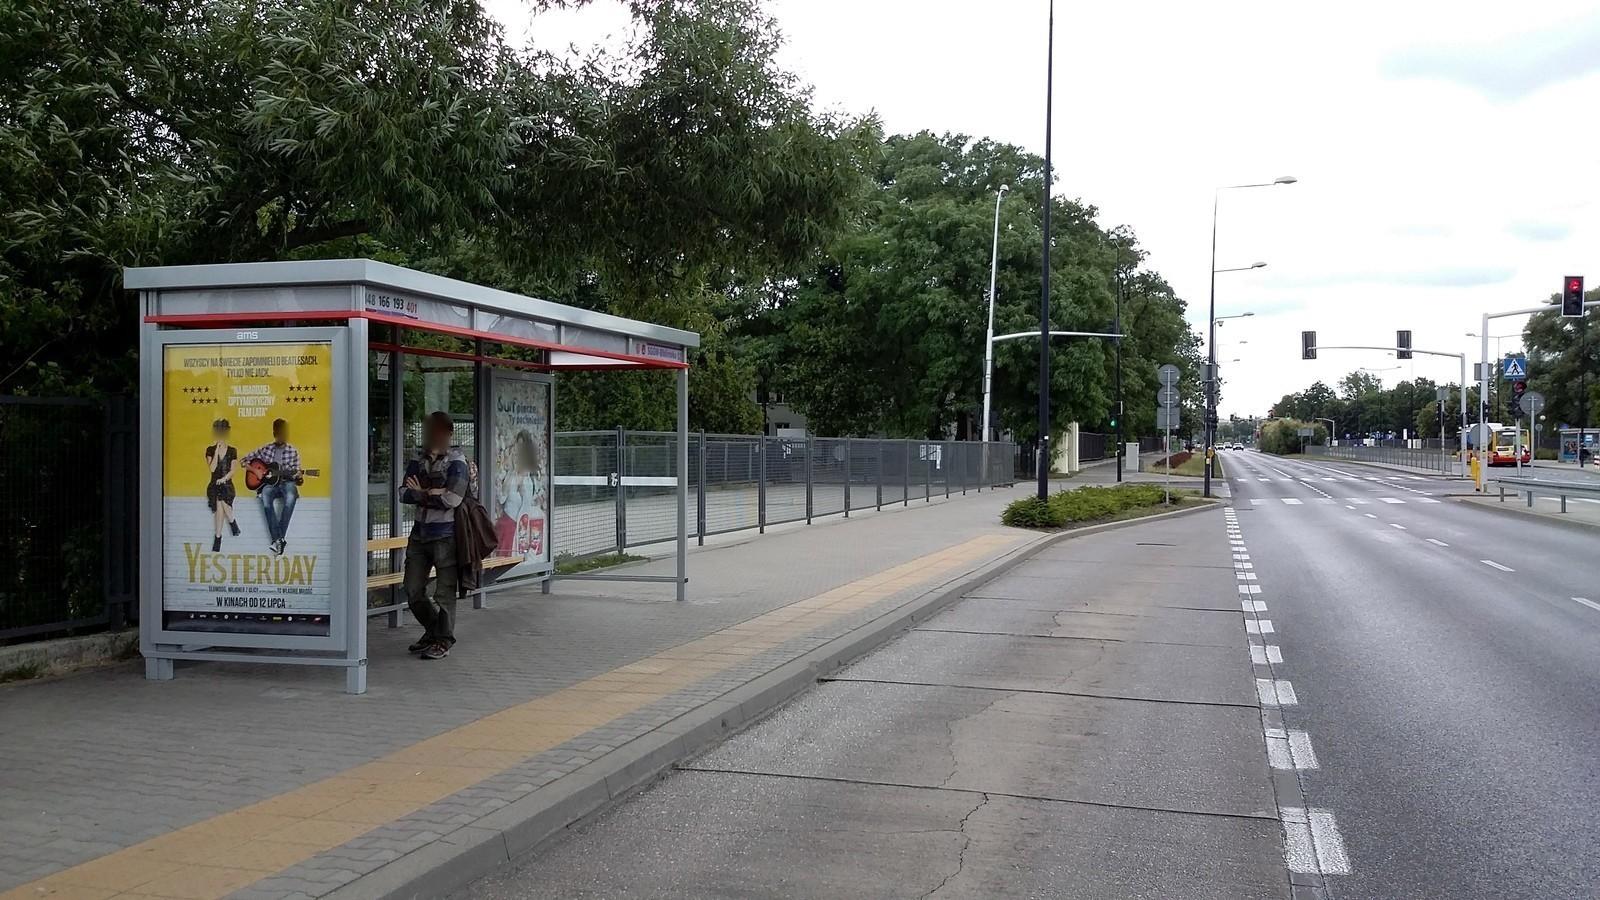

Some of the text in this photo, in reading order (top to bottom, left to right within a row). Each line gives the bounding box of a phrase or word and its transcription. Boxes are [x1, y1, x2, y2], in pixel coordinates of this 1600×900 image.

[379, 295, 390, 308] 166
[393, 297, 404, 310] 193
[406, 301, 418, 314] 401
[236, 331, 259, 340] ams
[183, 357, 210, 368] WSZYSCY
[210, 357, 218, 367] NA
[242, 356, 276, 367] ZAPOMNIELI
[276, 356, 281, 366] O
[226, 368, 244, 378] TYLKO
[245, 368, 255, 377] NIE
[496, 395, 516, 413] Surf
[238, 407, 251, 417] FILM
[183, 542, 317, 585] YESTERDAY
[216, 597, 286, 609] W KINACH OD 12 LIPCA
